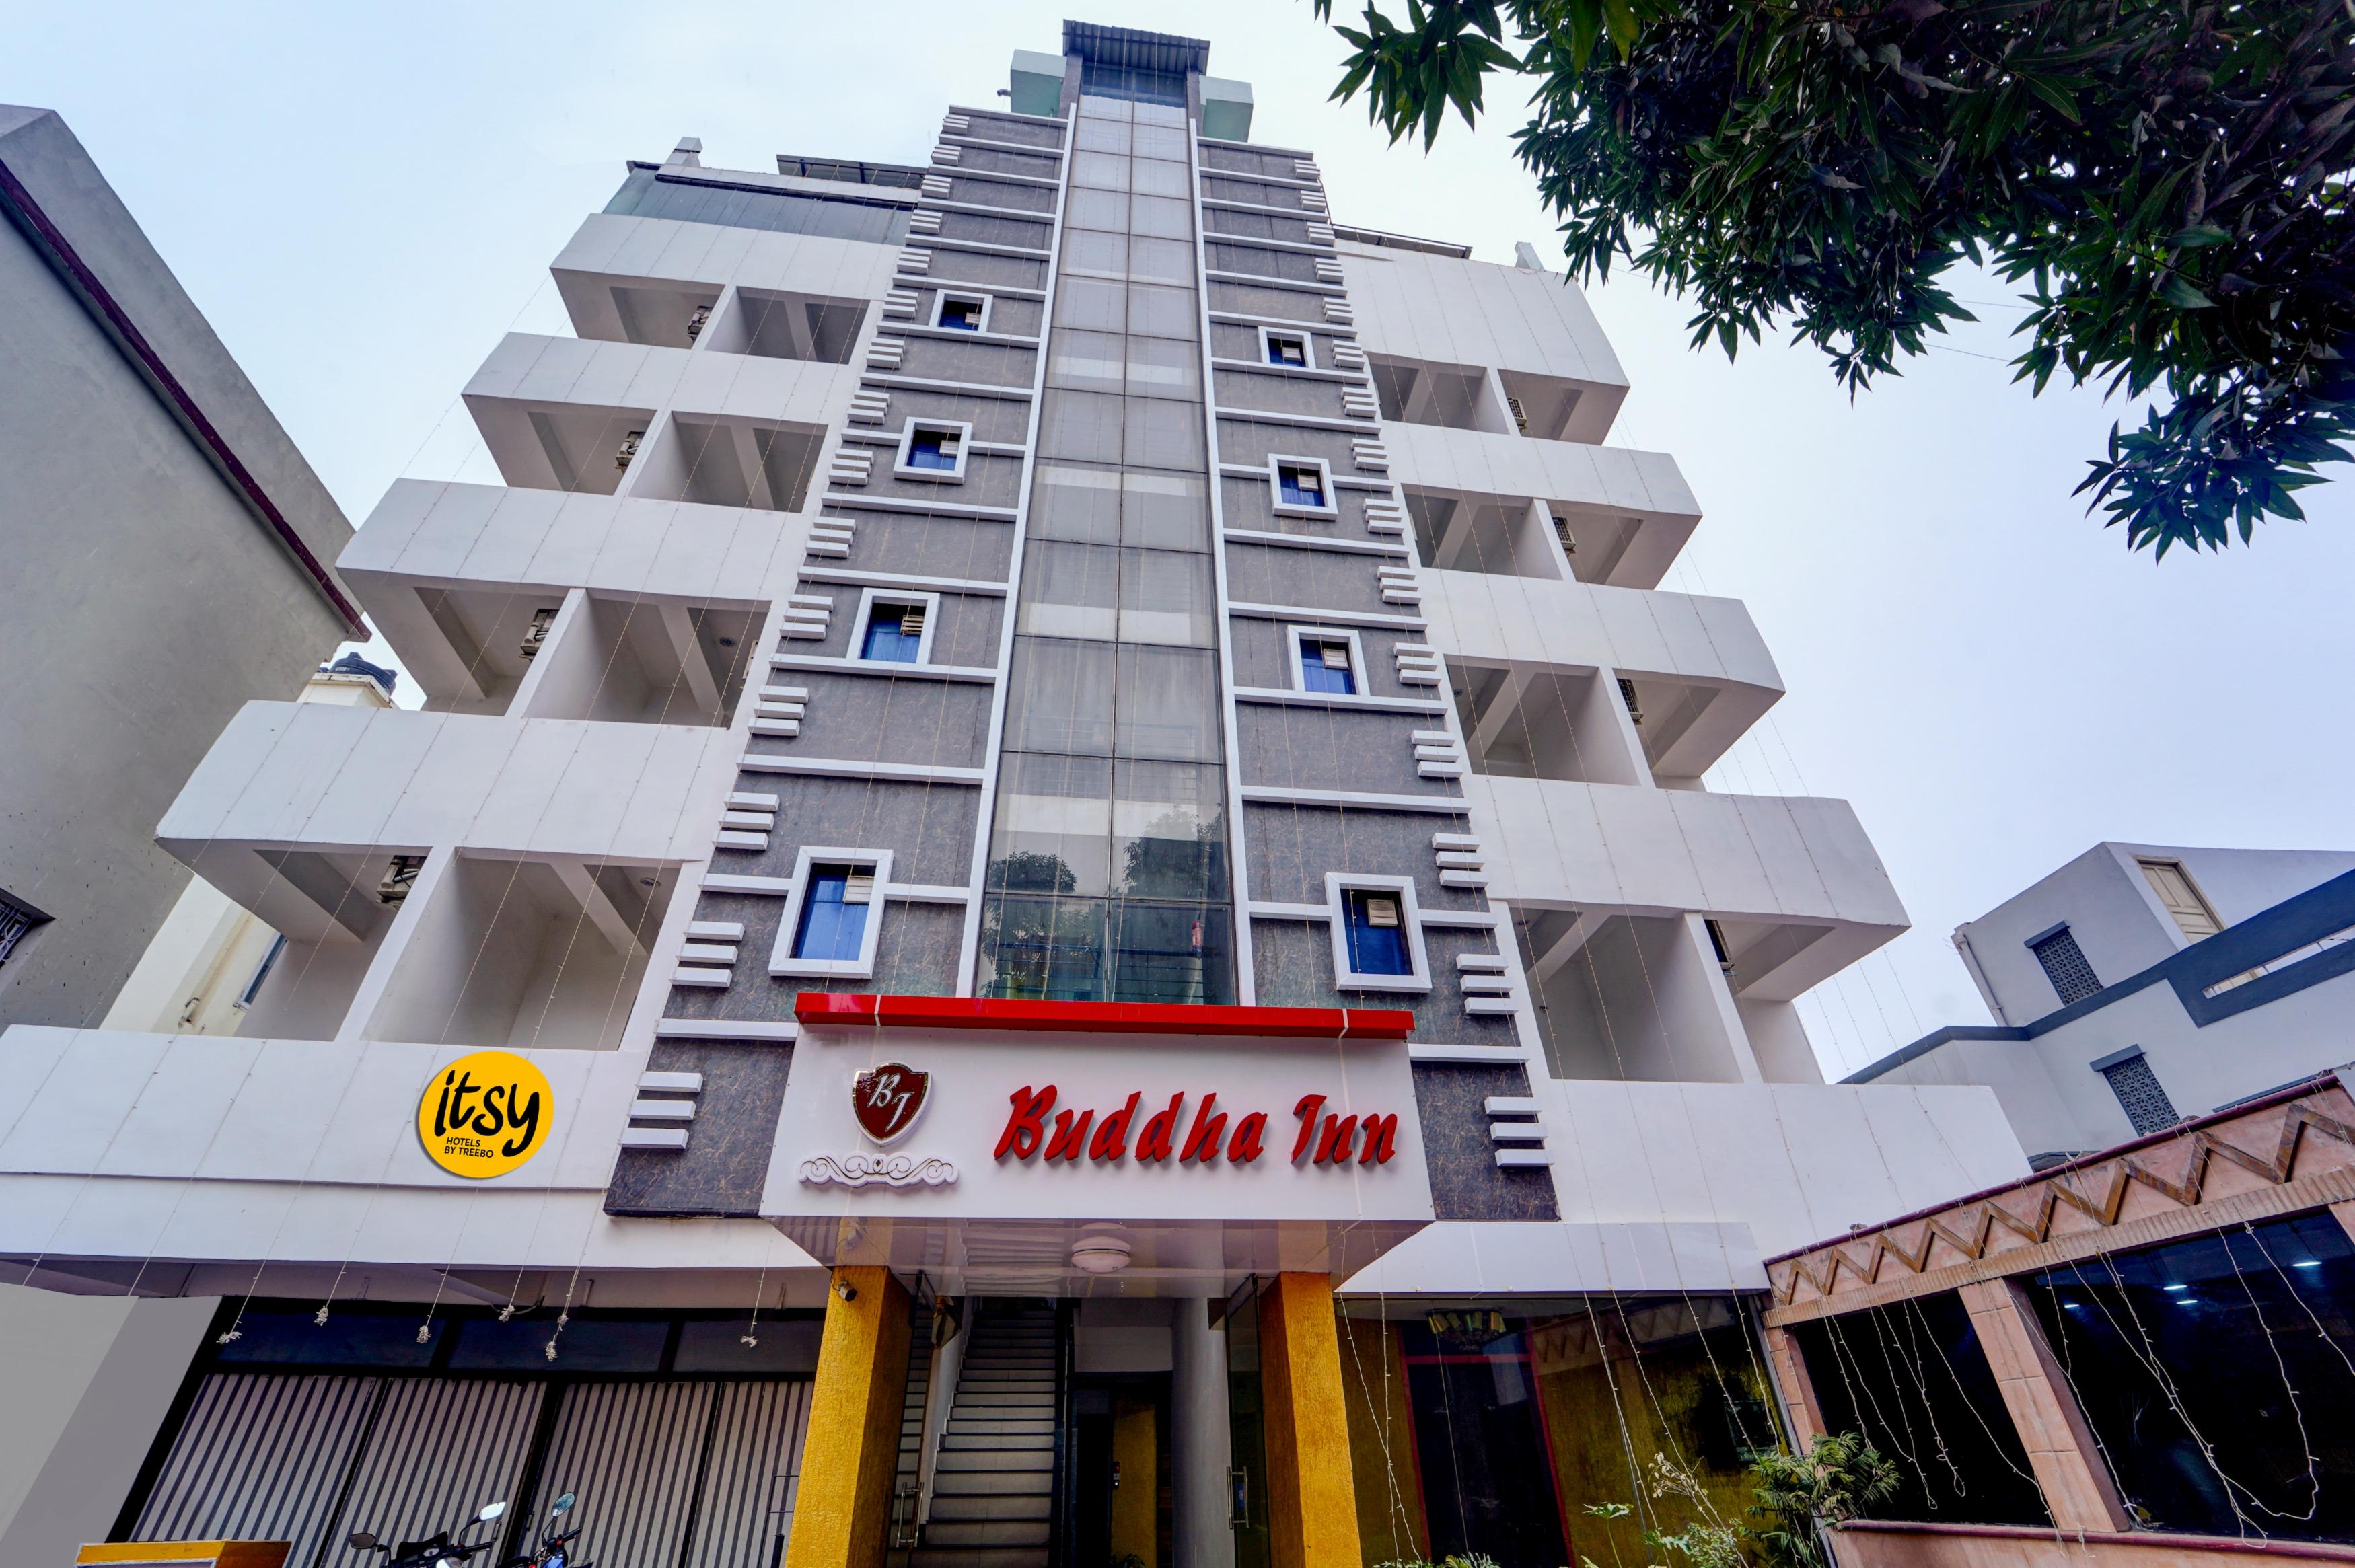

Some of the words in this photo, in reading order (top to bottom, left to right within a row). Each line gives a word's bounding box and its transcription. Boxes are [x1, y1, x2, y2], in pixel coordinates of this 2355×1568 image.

[434, 1070, 540, 1157] itsy
[994, 1084, 1268, 1162] Buddha
[1291, 1094, 1398, 1164] Inn
[444, 1146, 456, 1154] BY
[458, 1147, 494, 1158] TREEBO
[446, 1137, 481, 1147] HOTELS
